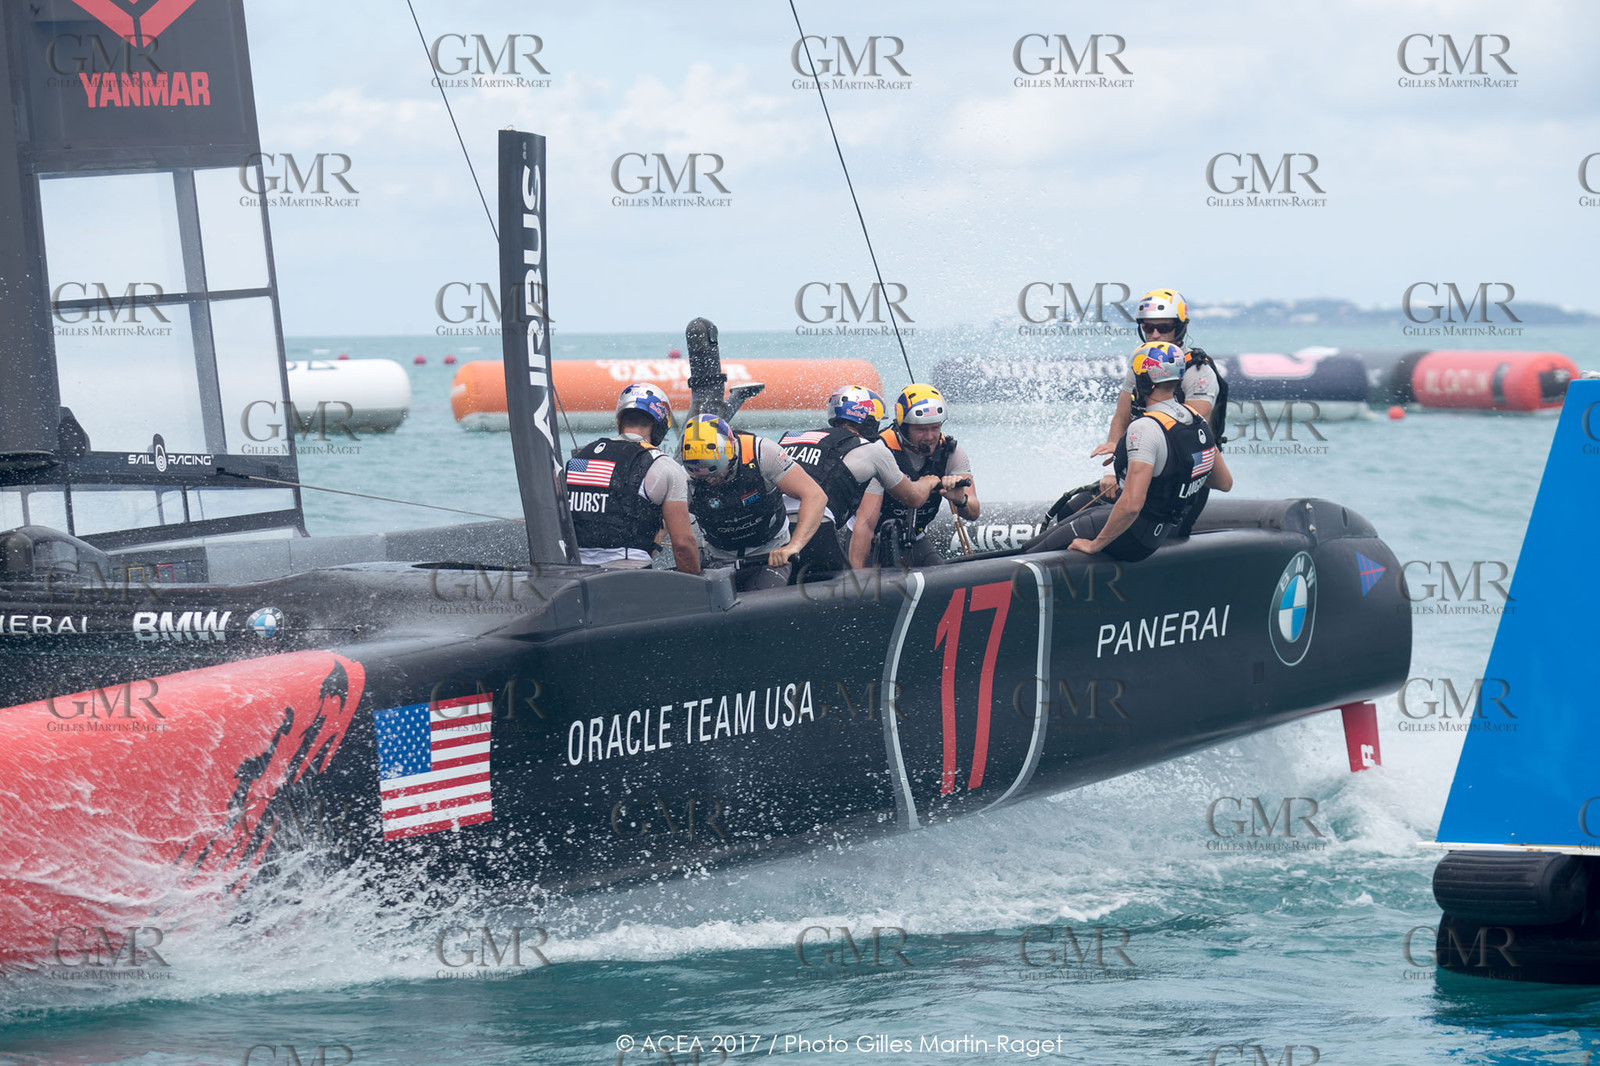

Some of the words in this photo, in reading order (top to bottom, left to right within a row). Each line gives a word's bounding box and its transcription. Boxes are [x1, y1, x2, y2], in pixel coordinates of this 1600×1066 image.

[79, 72, 211, 108] YANMAR
[523, 164, 554, 450] AIRBUS
[128, 454, 155, 465] SAIL
[167, 454, 212, 466] RACING
[784, 445, 822, 466] CLAIR
[568, 491, 609, 513] HURST
[132, 611, 232, 642] BMW
[1097, 594, 1231, 659] PANERAI
[934, 580, 1014, 797] 17
[567, 708, 673, 766] ORACLE
[683, 690, 757, 745] TEAM
[765, 680, 816, 730] USA
